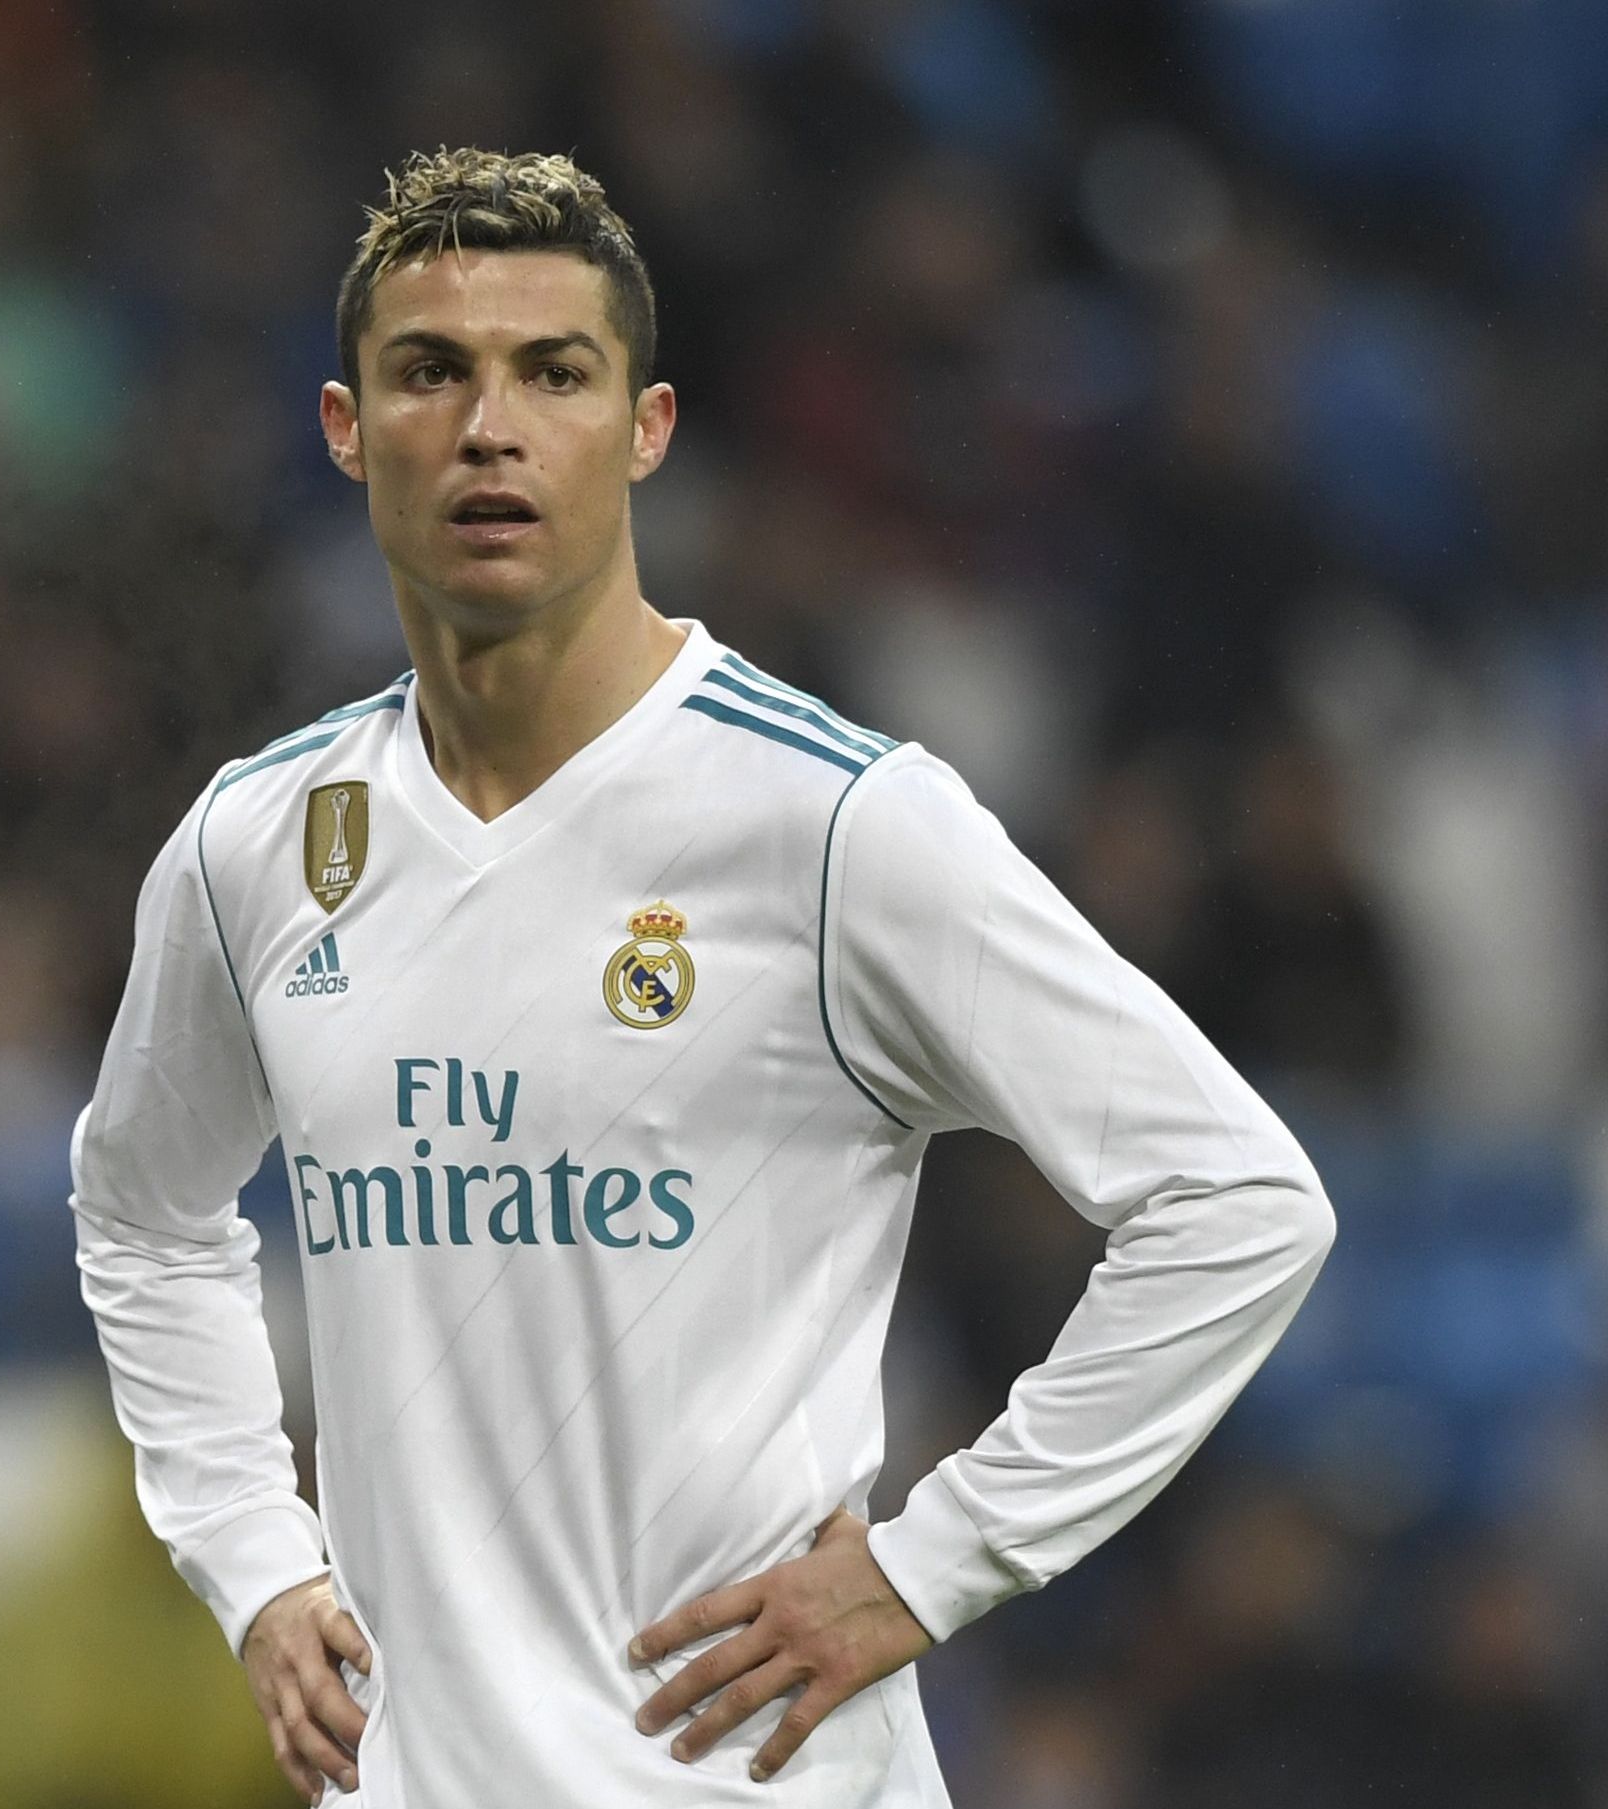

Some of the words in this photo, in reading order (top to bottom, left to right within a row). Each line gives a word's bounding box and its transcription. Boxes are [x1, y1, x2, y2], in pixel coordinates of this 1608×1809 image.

[322, 864, 349, 884] FIFA
[285, 973, 349, 998] adidas
[394, 1057, 520, 1143] Fly
[293, 1137, 695, 1256] Emirates
